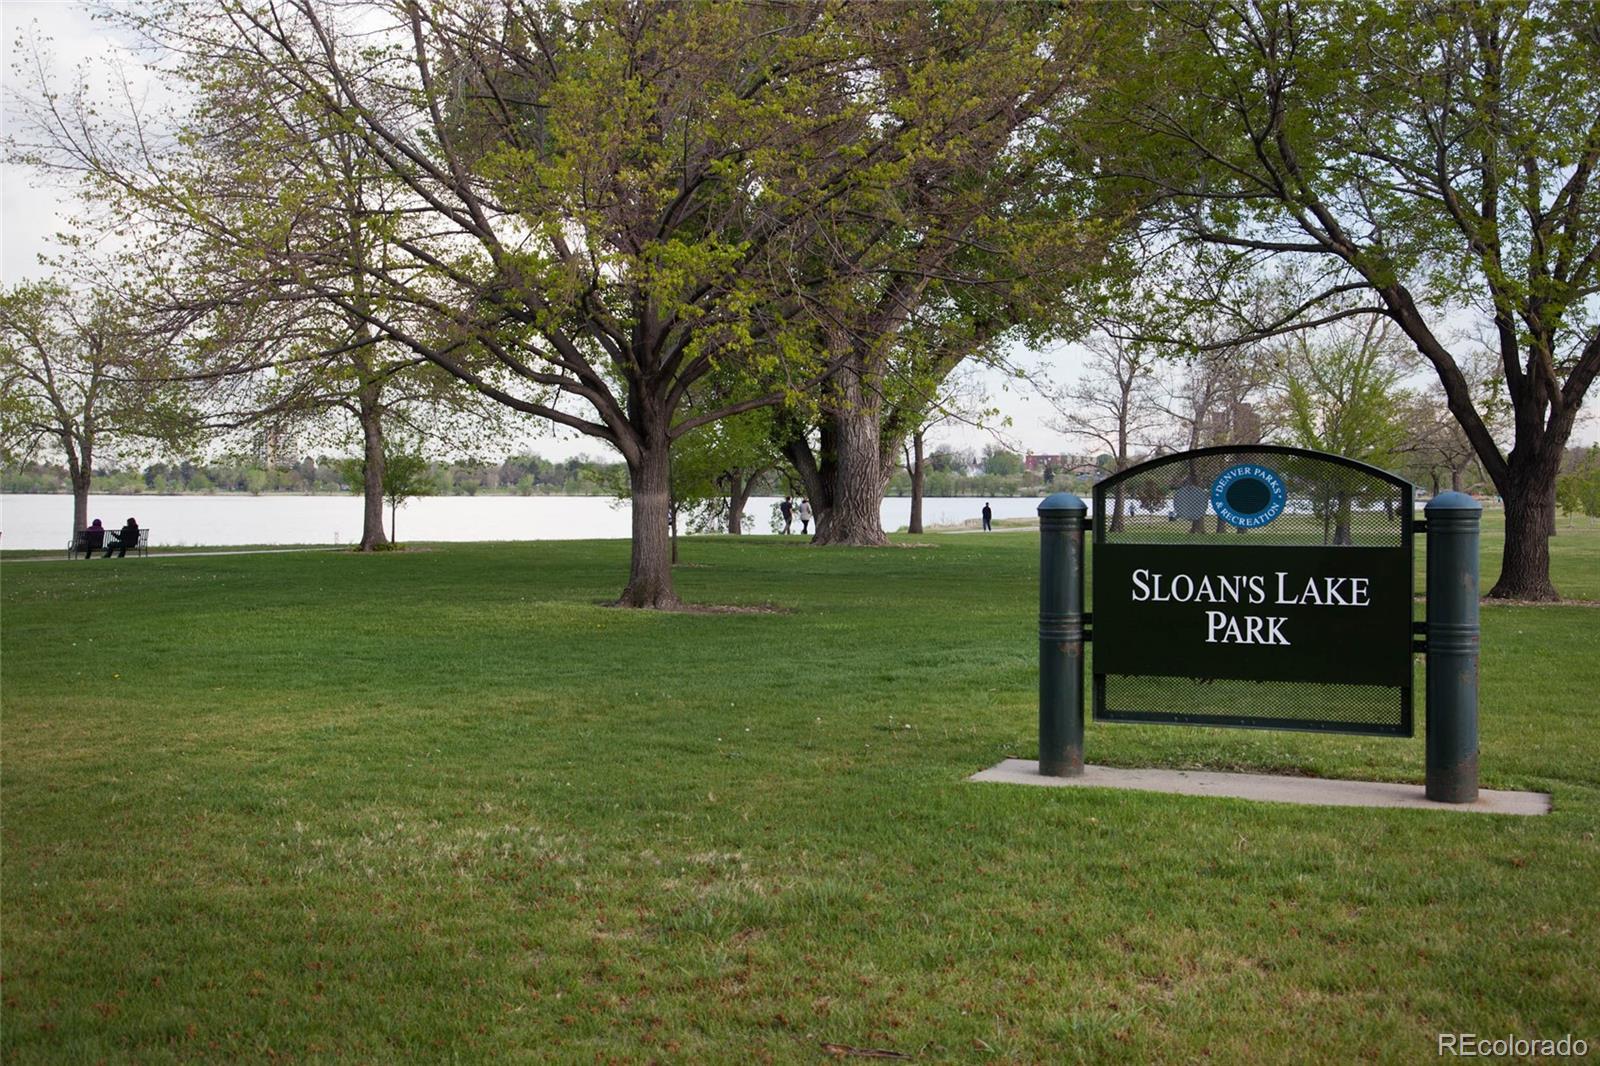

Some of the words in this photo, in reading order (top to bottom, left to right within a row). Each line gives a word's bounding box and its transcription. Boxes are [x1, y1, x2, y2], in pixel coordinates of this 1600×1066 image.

[1216, 467, 1251, 493] DENVER
[1254, 468, 1281, 494] PARKS
[1215, 501, 1224, 509] &
[1220, 502, 1280, 526] RECREATION
[1132, 568, 1266, 604] SLOAN'S
[1274, 572, 1371, 606] LAKE
[1205, 611, 1291, 645] PARK
